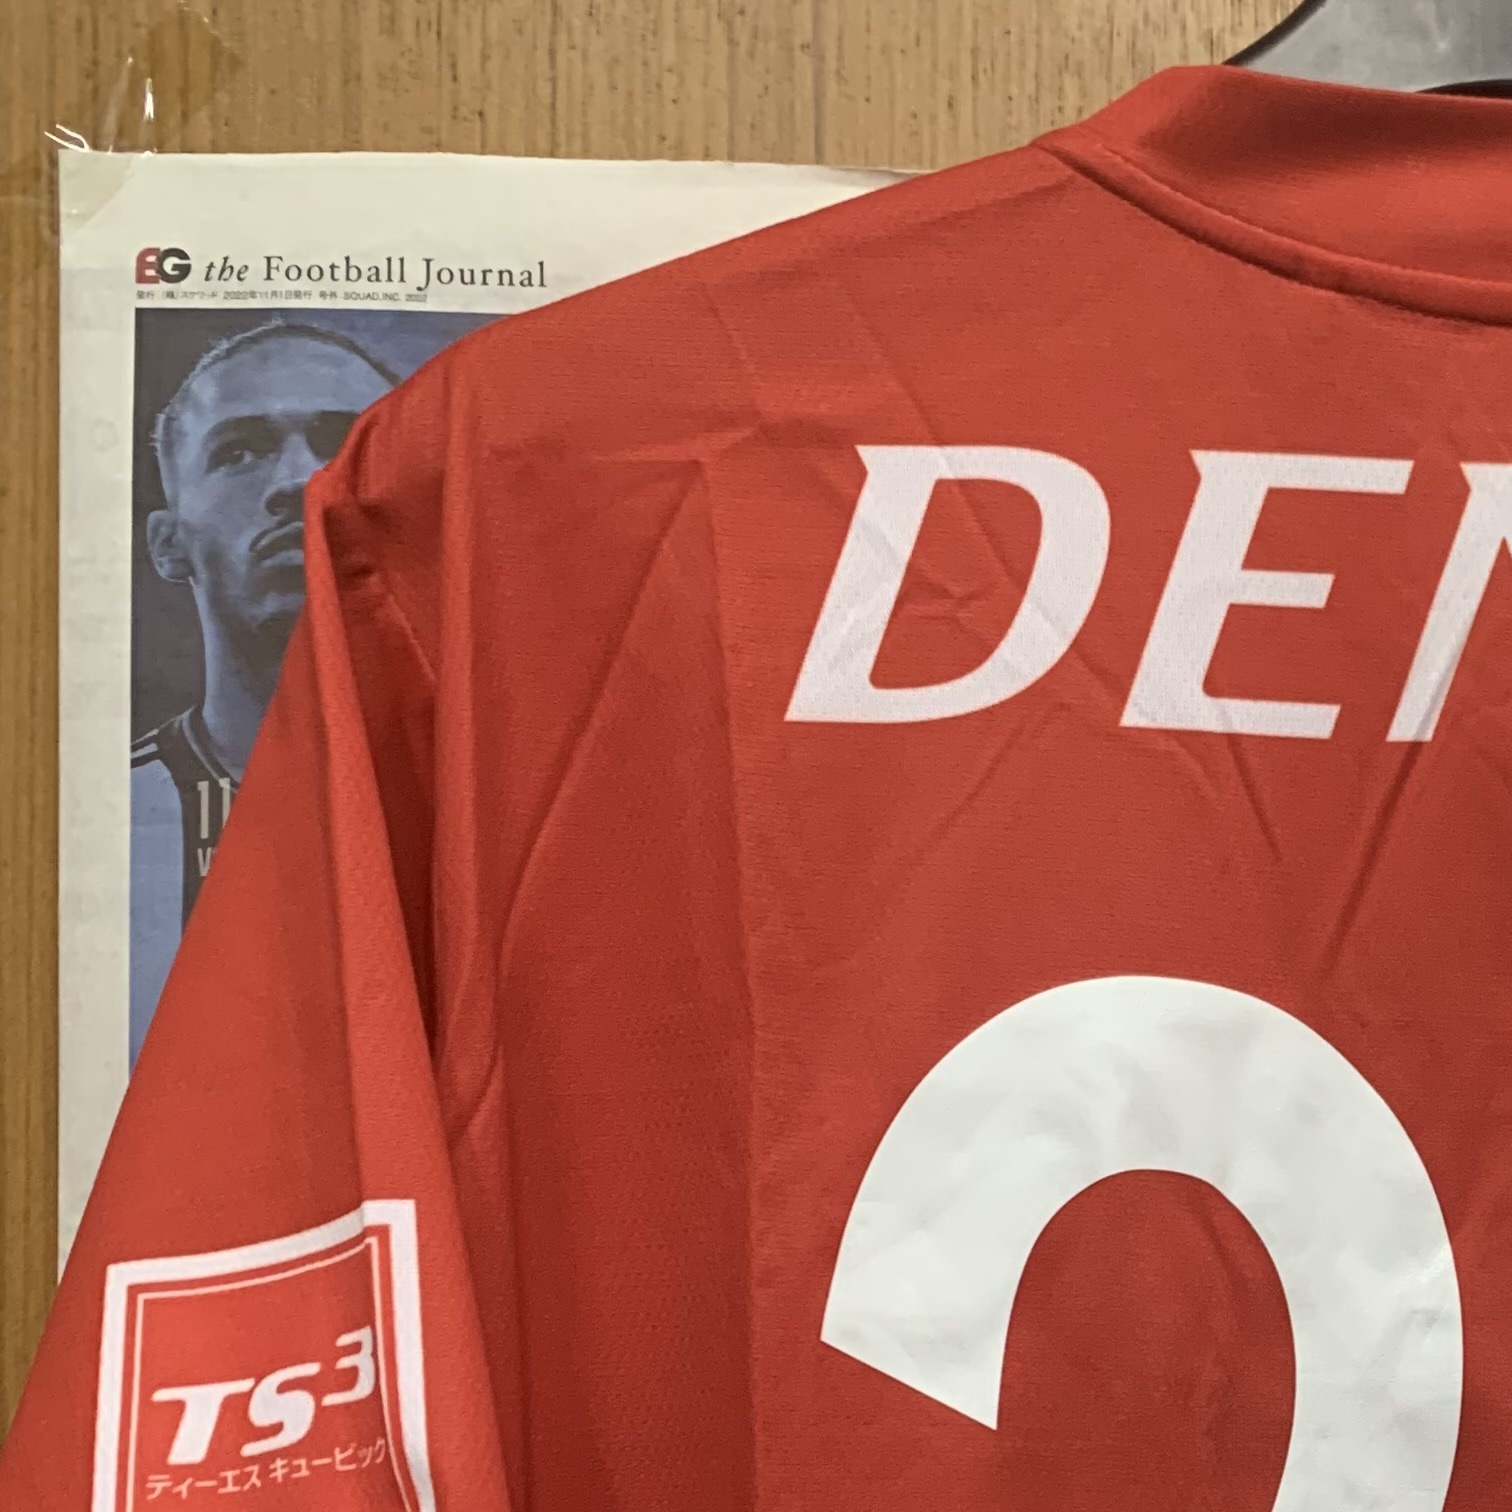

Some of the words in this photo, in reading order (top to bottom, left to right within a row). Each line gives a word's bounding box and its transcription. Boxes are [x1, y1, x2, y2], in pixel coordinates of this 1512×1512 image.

[203, 255, 249, 282] the
[263, 255, 406, 283] Football
[416, 258, 548, 292] Journal
[151, 1326, 376, 1466] TS3
[145, 1463, 263, 1501] ティーエス
